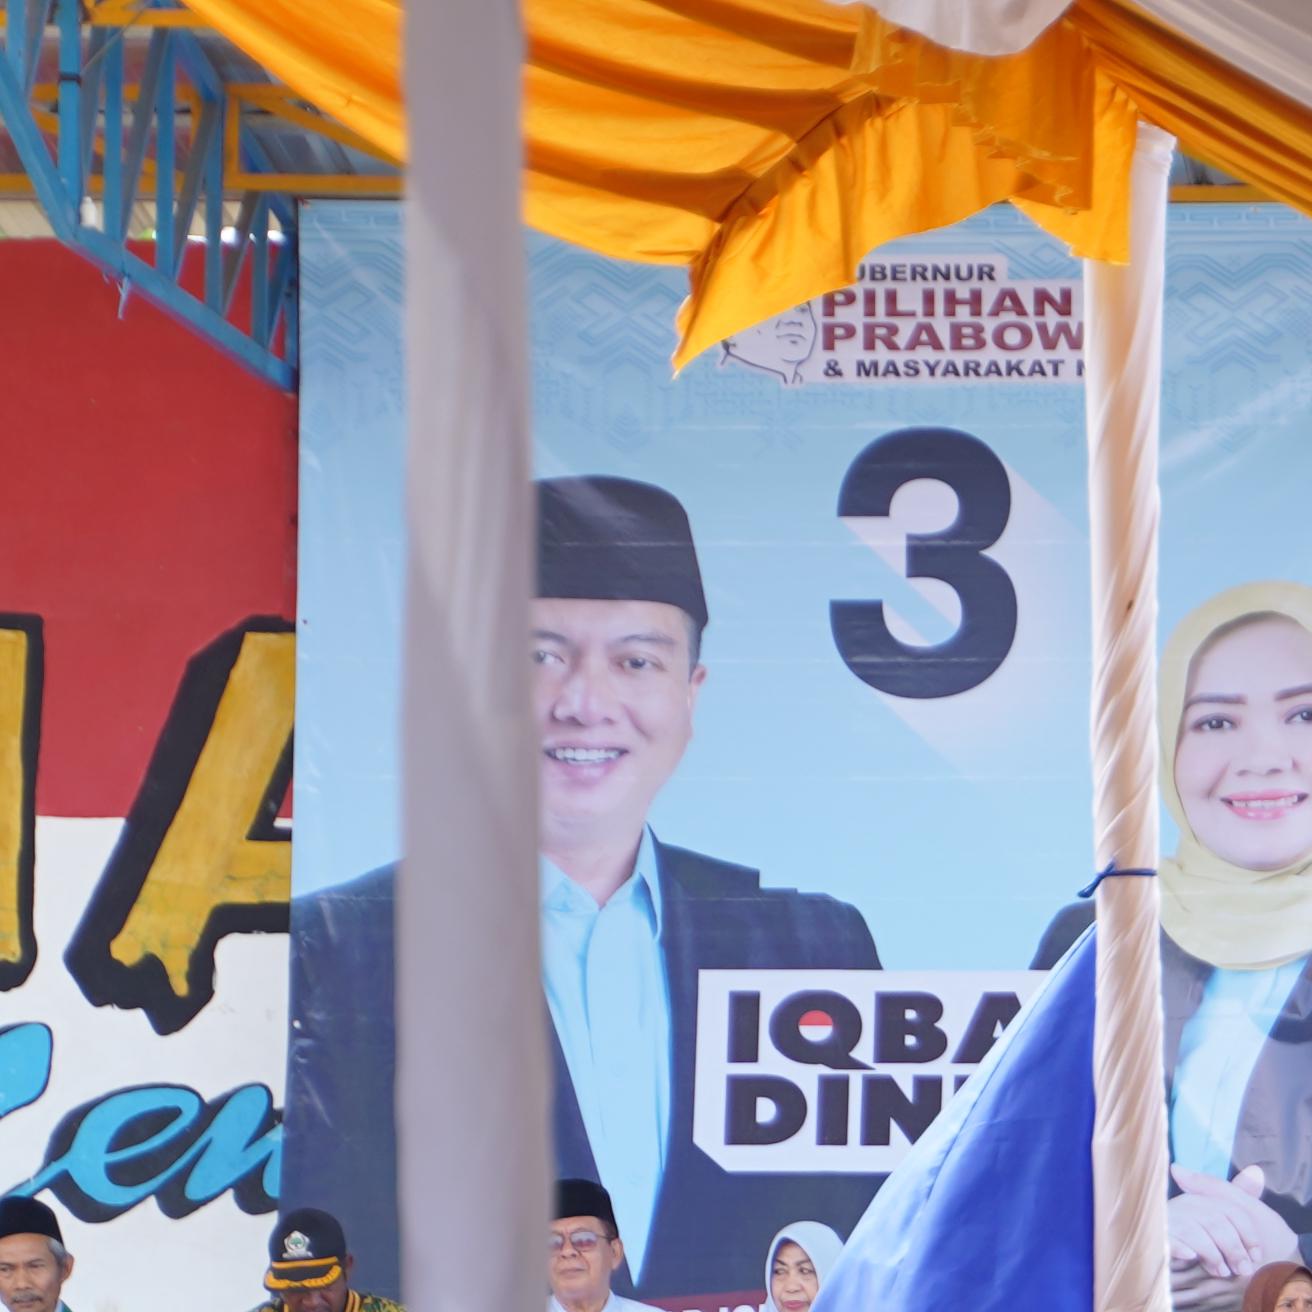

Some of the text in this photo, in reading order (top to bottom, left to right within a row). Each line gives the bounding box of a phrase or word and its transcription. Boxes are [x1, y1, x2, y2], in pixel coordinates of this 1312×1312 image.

[856, 263, 996, 282] BERNUR
[822, 287, 1072, 317] PILIHAN
[822, 321, 1084, 351] PRABOW
[823, 359, 843, 377] &
[855, 359, 1065, 377] MASYARAKAT
[829, 426, 1018, 699] 3
[727, 989, 1022, 1070] IQBA
[724, 1073, 971, 1146] DIN
